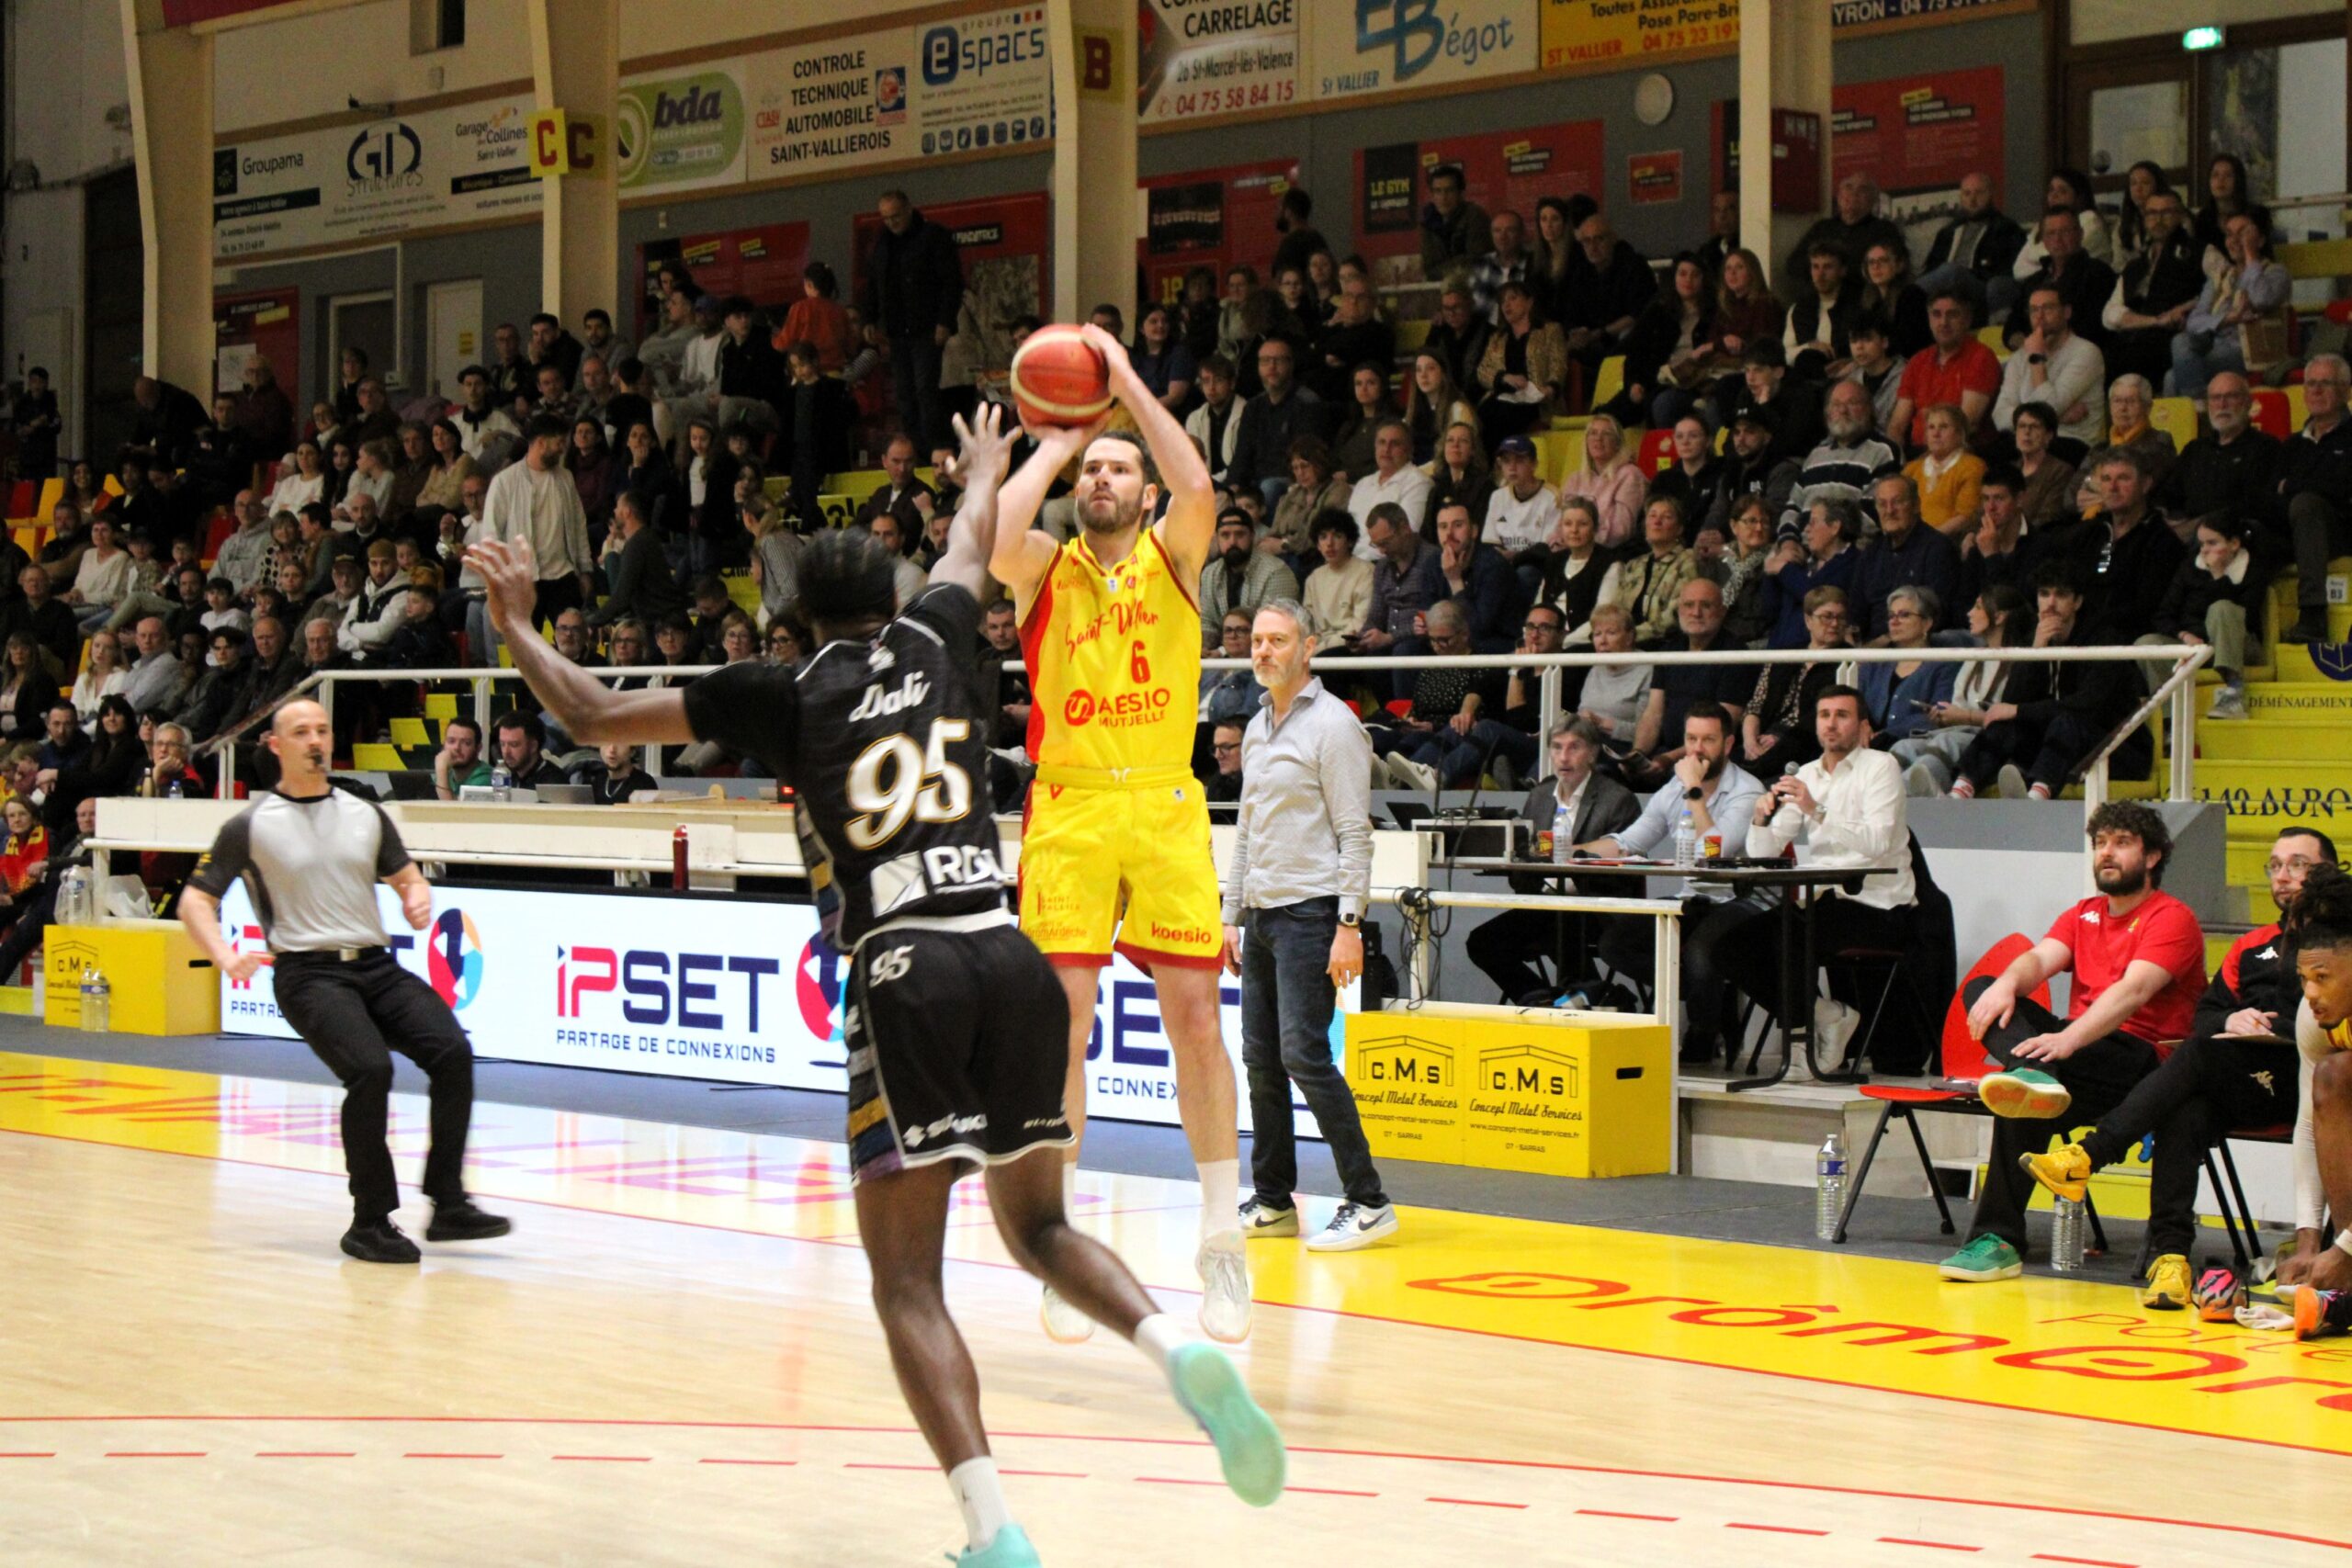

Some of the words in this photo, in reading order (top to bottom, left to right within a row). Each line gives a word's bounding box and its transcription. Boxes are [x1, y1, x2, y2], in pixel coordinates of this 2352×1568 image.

[961, 15, 1011, 33] groupe
[1183, 0, 1293, 38] CARRELAGE
[922, 27, 1045, 85] espacs
[1546, 48, 1562, 65] ST
[1567, 38, 1623, 61] VALLIER
[1643, 33, 1661, 51] 04
[1667, 30, 1684, 48] 75
[1690, 26, 1708, 44] 23
[1714, 22, 1733, 40] 19
[793, 51, 865, 79] CONTROLE
[1082, 36, 1112, 91] B
[653, 85, 723, 130] bda
[791, 77, 869, 107] TECHNIQUE
[1175, 95, 1196, 115] 04
[1200, 91, 1220, 111] 75
[1225, 88, 1245, 108] 58
[1250, 85, 1270, 106] 84
[1275, 80, 1295, 101] 15
[456, 121, 489, 138] Garage
[486, 126, 528, 144] Collines
[786, 105, 875, 136] AUTOMOBILE
[537, 119, 558, 167] C
[567, 121, 594, 170] C
[771, 130, 891, 164] SAINT-VALLIEROIS
[242, 152, 304, 175] Groupama
[1131, 639, 1151, 684] 6
[843, 716, 972, 851] 95
[1150, 921, 1212, 944] koesio
[869, 943, 915, 987] 95
[557, 1030, 631, 1051] PARTAGE
[639, 1036, 659, 1053] DE
[666, 1039, 776, 1064] CONNEXIONS
[1469, 1099, 1506, 1116] Concept
[1508, 1102, 1539, 1117] Metal
[1542, 1104, 1583, 1121] Services
